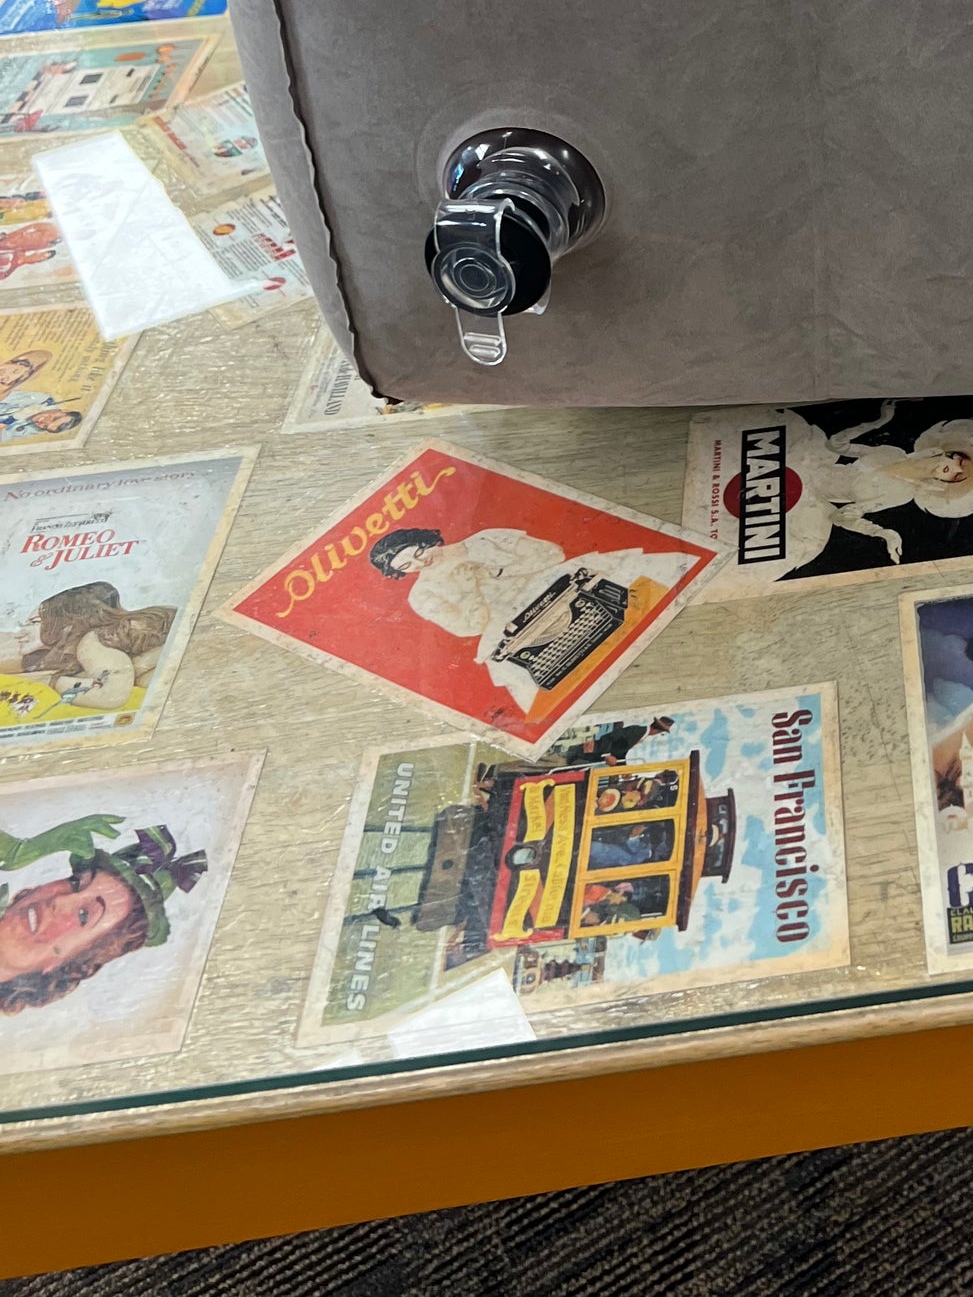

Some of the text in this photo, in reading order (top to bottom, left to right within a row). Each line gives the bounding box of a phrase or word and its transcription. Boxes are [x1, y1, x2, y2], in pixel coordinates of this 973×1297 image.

[713, 439, 722, 472] MARTINI
[30, 479, 115, 498] ordinary
[711, 482, 720, 507] ROSSI
[744, 430, 781, 560] MARTINI
[710, 508, 719, 527] S.A.
[20, 529, 116, 554] ROMEO
[29, 540, 140, 571] & JULIET
[276, 467, 457, 619] Olivetti
[771, 709, 820, 943] San Francisco
[346, 762, 414, 1011] UNITED AIR LINES
